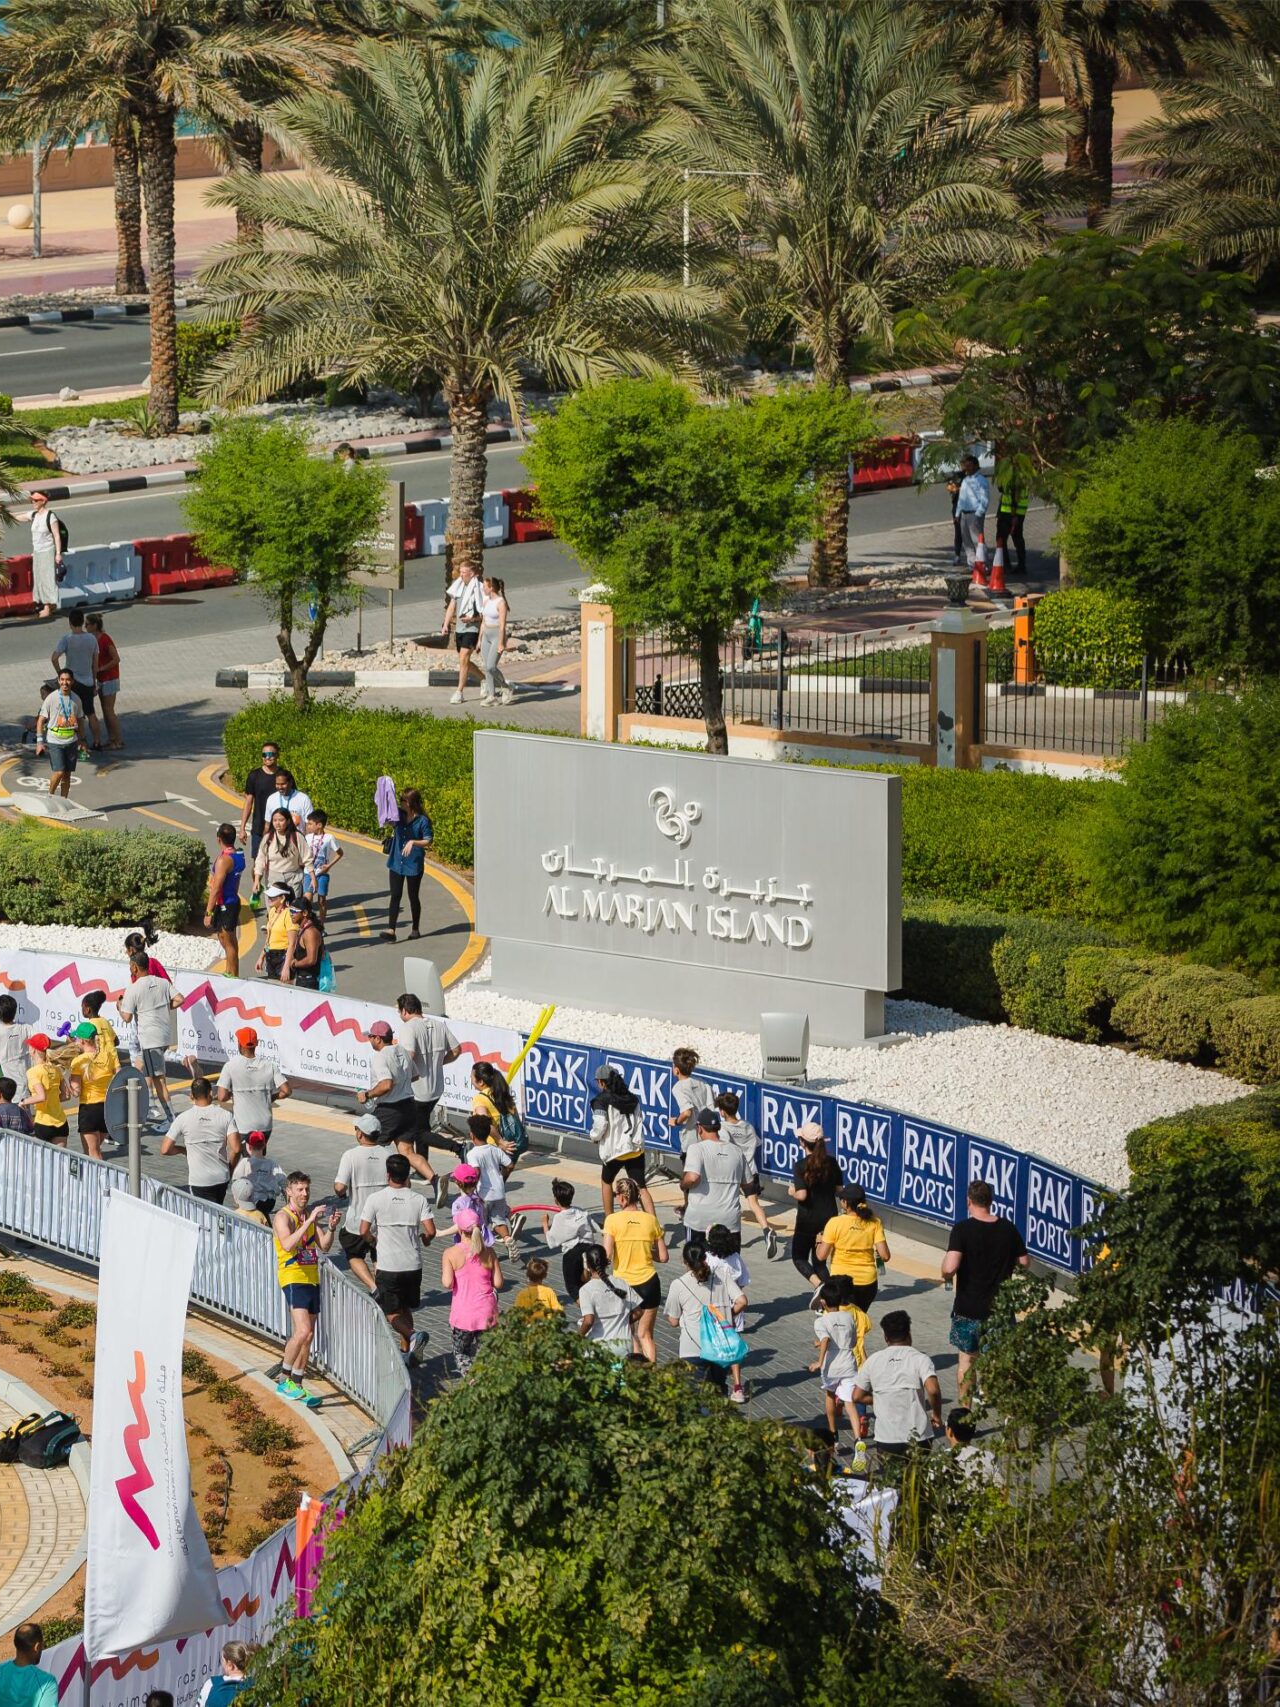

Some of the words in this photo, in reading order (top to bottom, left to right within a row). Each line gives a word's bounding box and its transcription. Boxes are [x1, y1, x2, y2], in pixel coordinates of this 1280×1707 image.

[542, 885, 579, 918] AL
[582, 888, 697, 934] MARJAN
[706, 902, 814, 950] ISLAND
[45, 1008, 62, 1021] ras
[181, 1027, 202, 1039] ras
[208, 1031, 222, 1042] al
[300, 1047, 320, 1060] ras
[327, 1050, 339, 1064] al
[300, 1062, 324, 1073] tourism
[324, 1066, 369, 1081] development
[524, 1046, 586, 1091] RAK
[444, 1074, 457, 1087] al
[611, 1062, 669, 1109] AK
[525, 1087, 585, 1124] PORTS
[837, 1111, 888, 1159] RAK
[904, 1129, 954, 1179] RAK
[837, 1155, 886, 1198] PORTS
[902, 1172, 954, 1215] PORTS
[970, 1148, 1015, 1201] RAK
[1028, 1170, 1070, 1224] RAK
[1027, 1214, 1071, 1259] PORTS
[177, 1669, 196, 1688] ras
[201, 1656, 213, 1676] al
